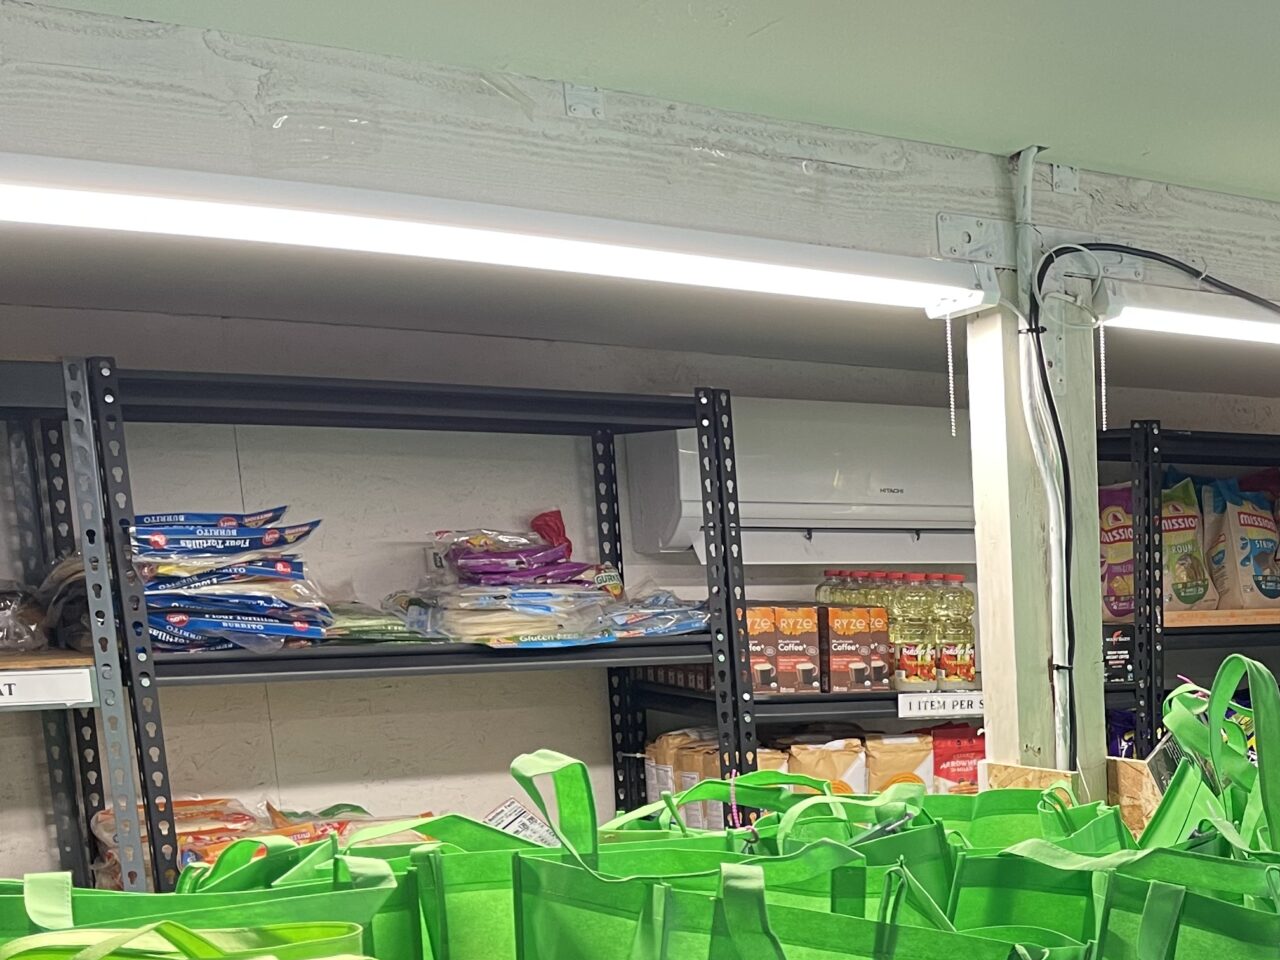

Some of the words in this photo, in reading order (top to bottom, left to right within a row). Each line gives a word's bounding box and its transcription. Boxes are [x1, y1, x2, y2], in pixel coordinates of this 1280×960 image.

[196, 528, 237, 537] BURRITO
[180, 539, 225, 549] Tortillas
[225, 539, 250, 548] Flour
[222, 621, 265, 630] BURRITO
[918, 700, 946, 711] ITEM
[952, 700, 974, 710] PER
